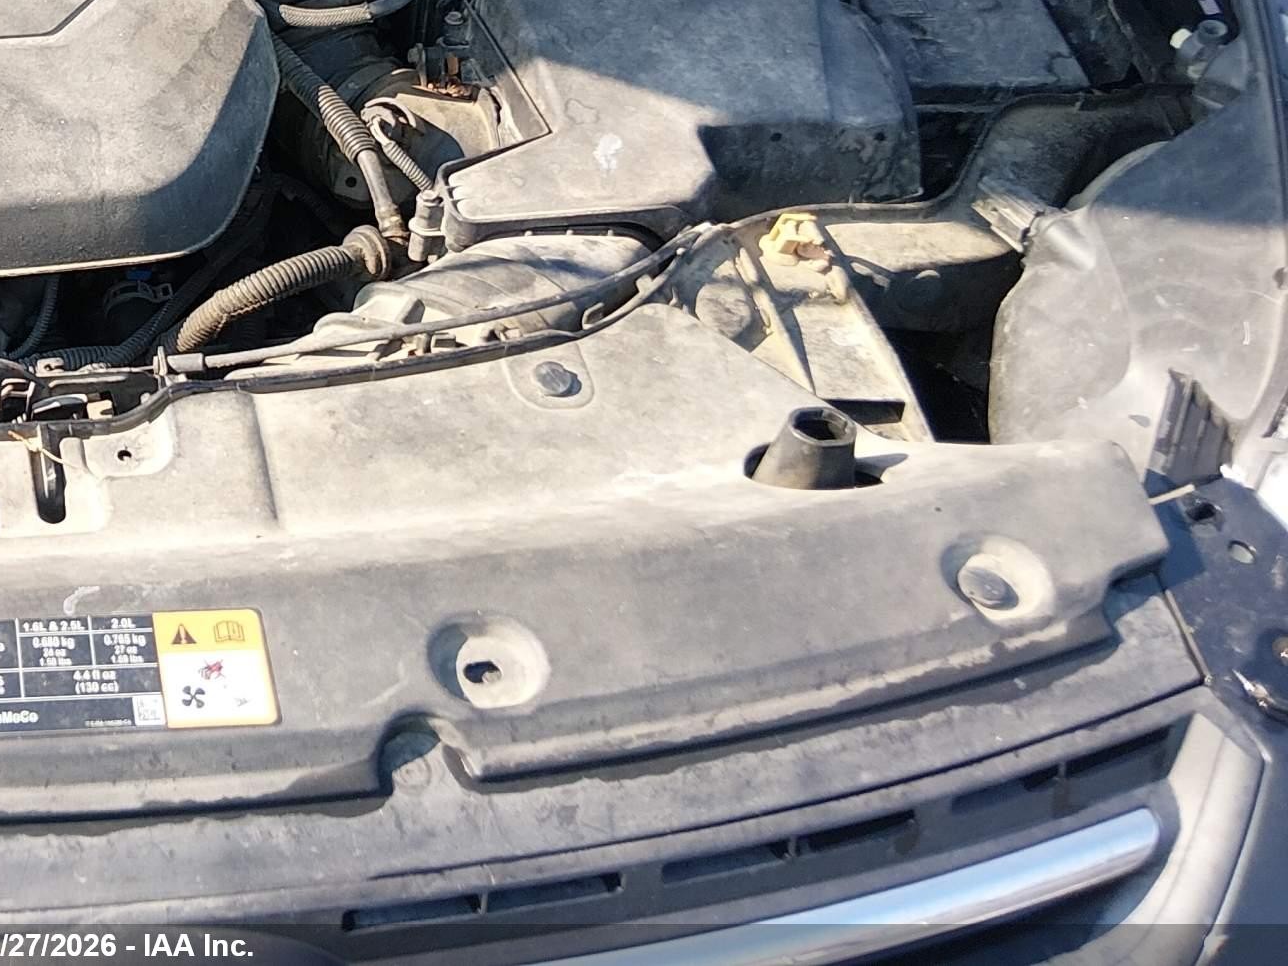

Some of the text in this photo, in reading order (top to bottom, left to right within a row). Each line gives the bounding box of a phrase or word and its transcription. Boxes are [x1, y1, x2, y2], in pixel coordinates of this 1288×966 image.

[111, 618, 136, 628] 2.0L
[61, 636, 75, 649] kg
[132, 634, 146, 647] kg
